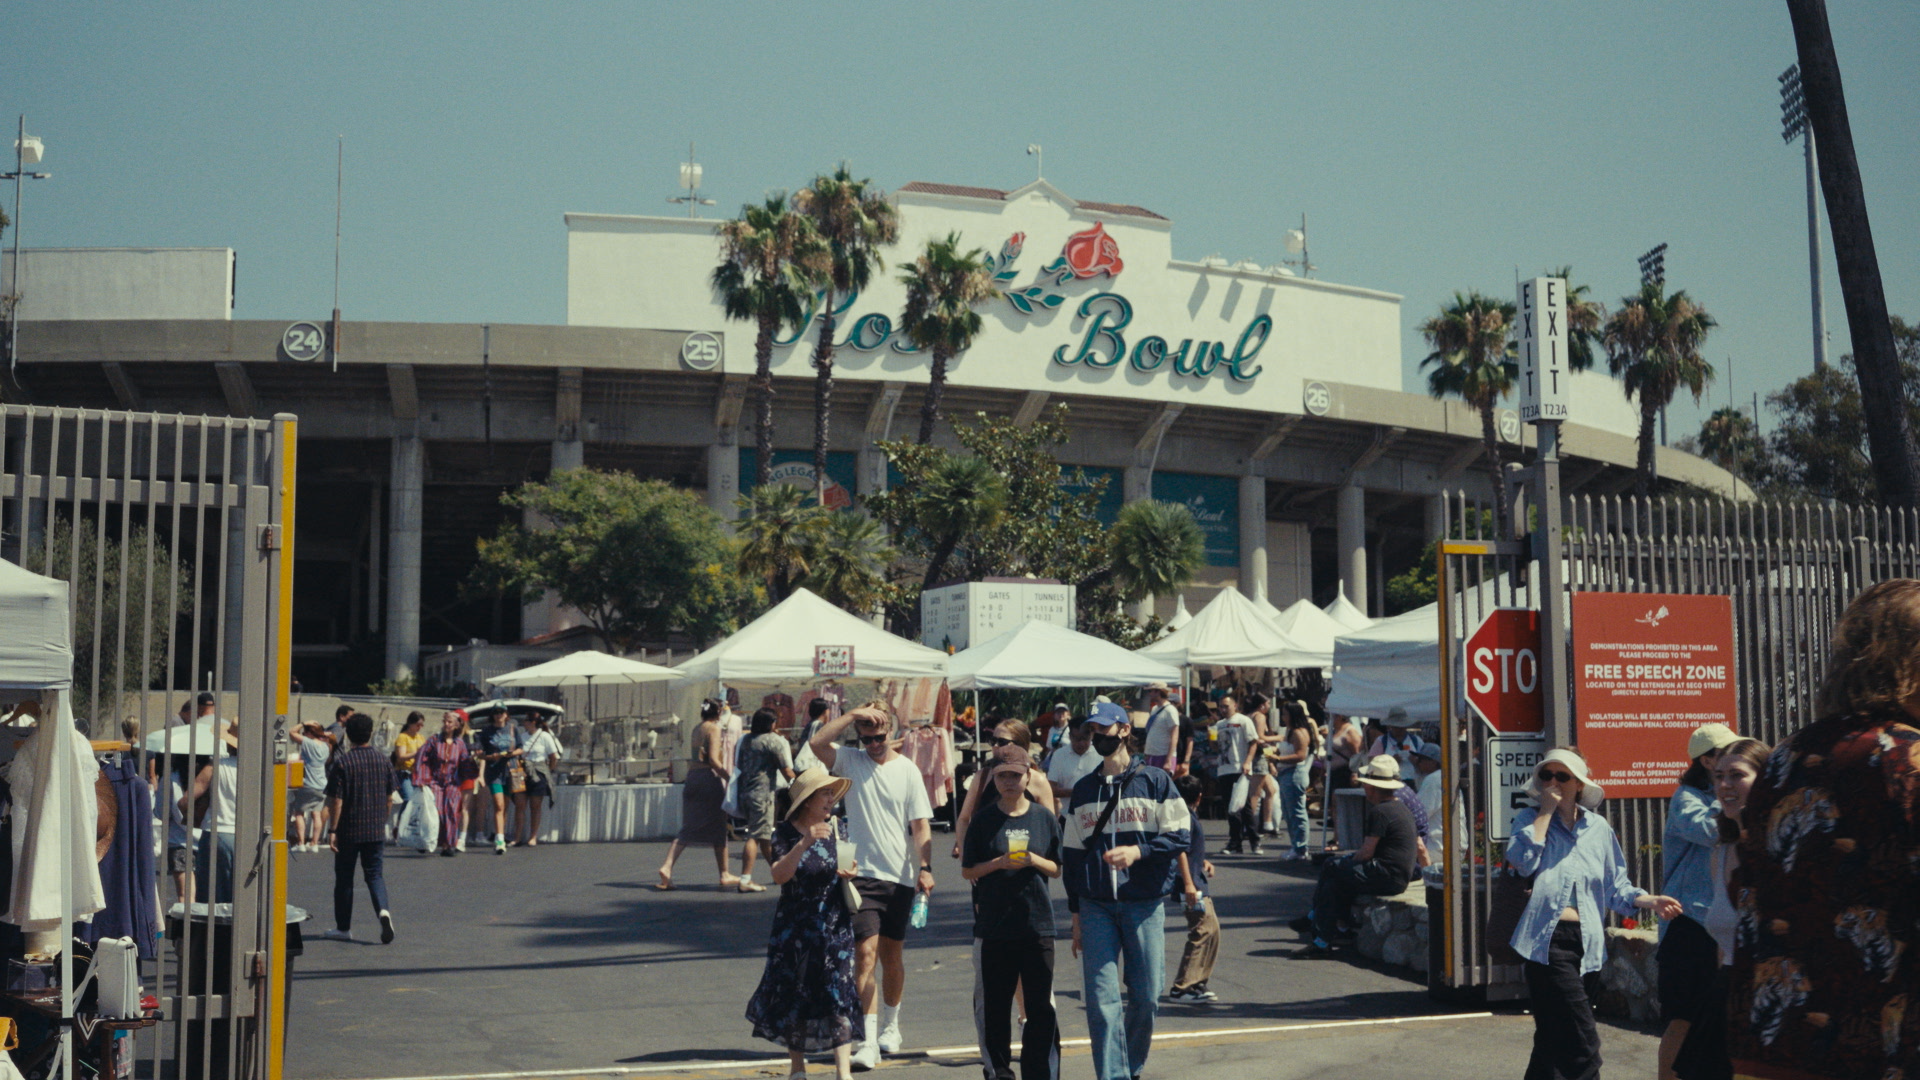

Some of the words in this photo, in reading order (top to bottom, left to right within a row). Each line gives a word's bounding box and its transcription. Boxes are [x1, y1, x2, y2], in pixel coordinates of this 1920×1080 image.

[289, 330, 320, 351] 24
[1054, 292, 1272, 382] Bowl
[1523, 283, 1534, 397] EXIT
[1547, 282, 1559, 395] EXIT
[687, 340, 718, 361] 25
[1308, 388, 1328, 408] 26
[1522, 404, 1540, 418] T23A
[1544, 404, 1567, 416] T23A
[1502, 417, 1518, 435] 27
[989, 592, 1010, 600] GATES
[1034, 593, 1064, 601] TUNNELS
[1472, 647, 1537, 693] STO
[1585, 664, 1622, 679] FREE
[1626, 664, 1682, 679] SPEECH
[1686, 665, 1726, 679] ZONE
[1664, 721, 1689, 729] CODE(S)
